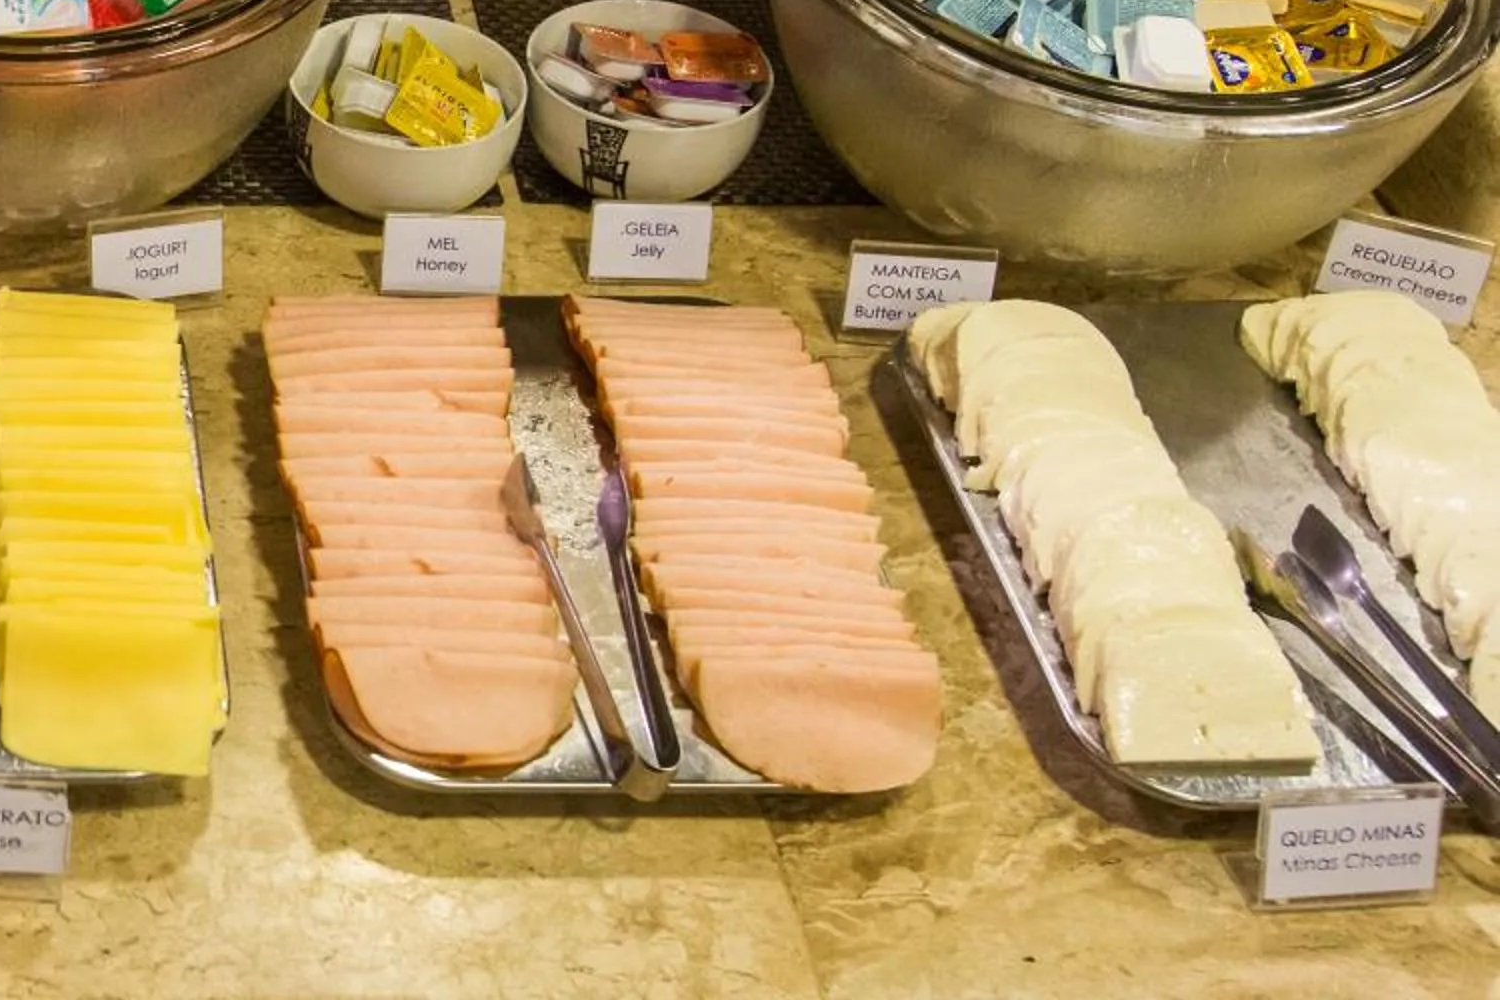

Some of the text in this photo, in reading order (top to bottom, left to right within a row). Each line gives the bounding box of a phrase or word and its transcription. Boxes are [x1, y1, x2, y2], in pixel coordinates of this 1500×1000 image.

[624, 221, 680, 237] GELEIA
[427, 237, 459, 251] MEL
[631, 243, 665, 259] Jelly
[416, 257, 468, 275] Honey
[1350, 243, 1456, 280] REQUEIJÃO
[871, 263, 962, 281] MANTEIGA
[1330, 260, 1468, 305] Cream Cheese
[866, 283, 947, 303] COM SAL
[854, 305, 903, 321] Butter
[1280, 822, 1427, 848] QUEIJO MINAS
[1282, 851, 1423, 873] Minas Cheese
